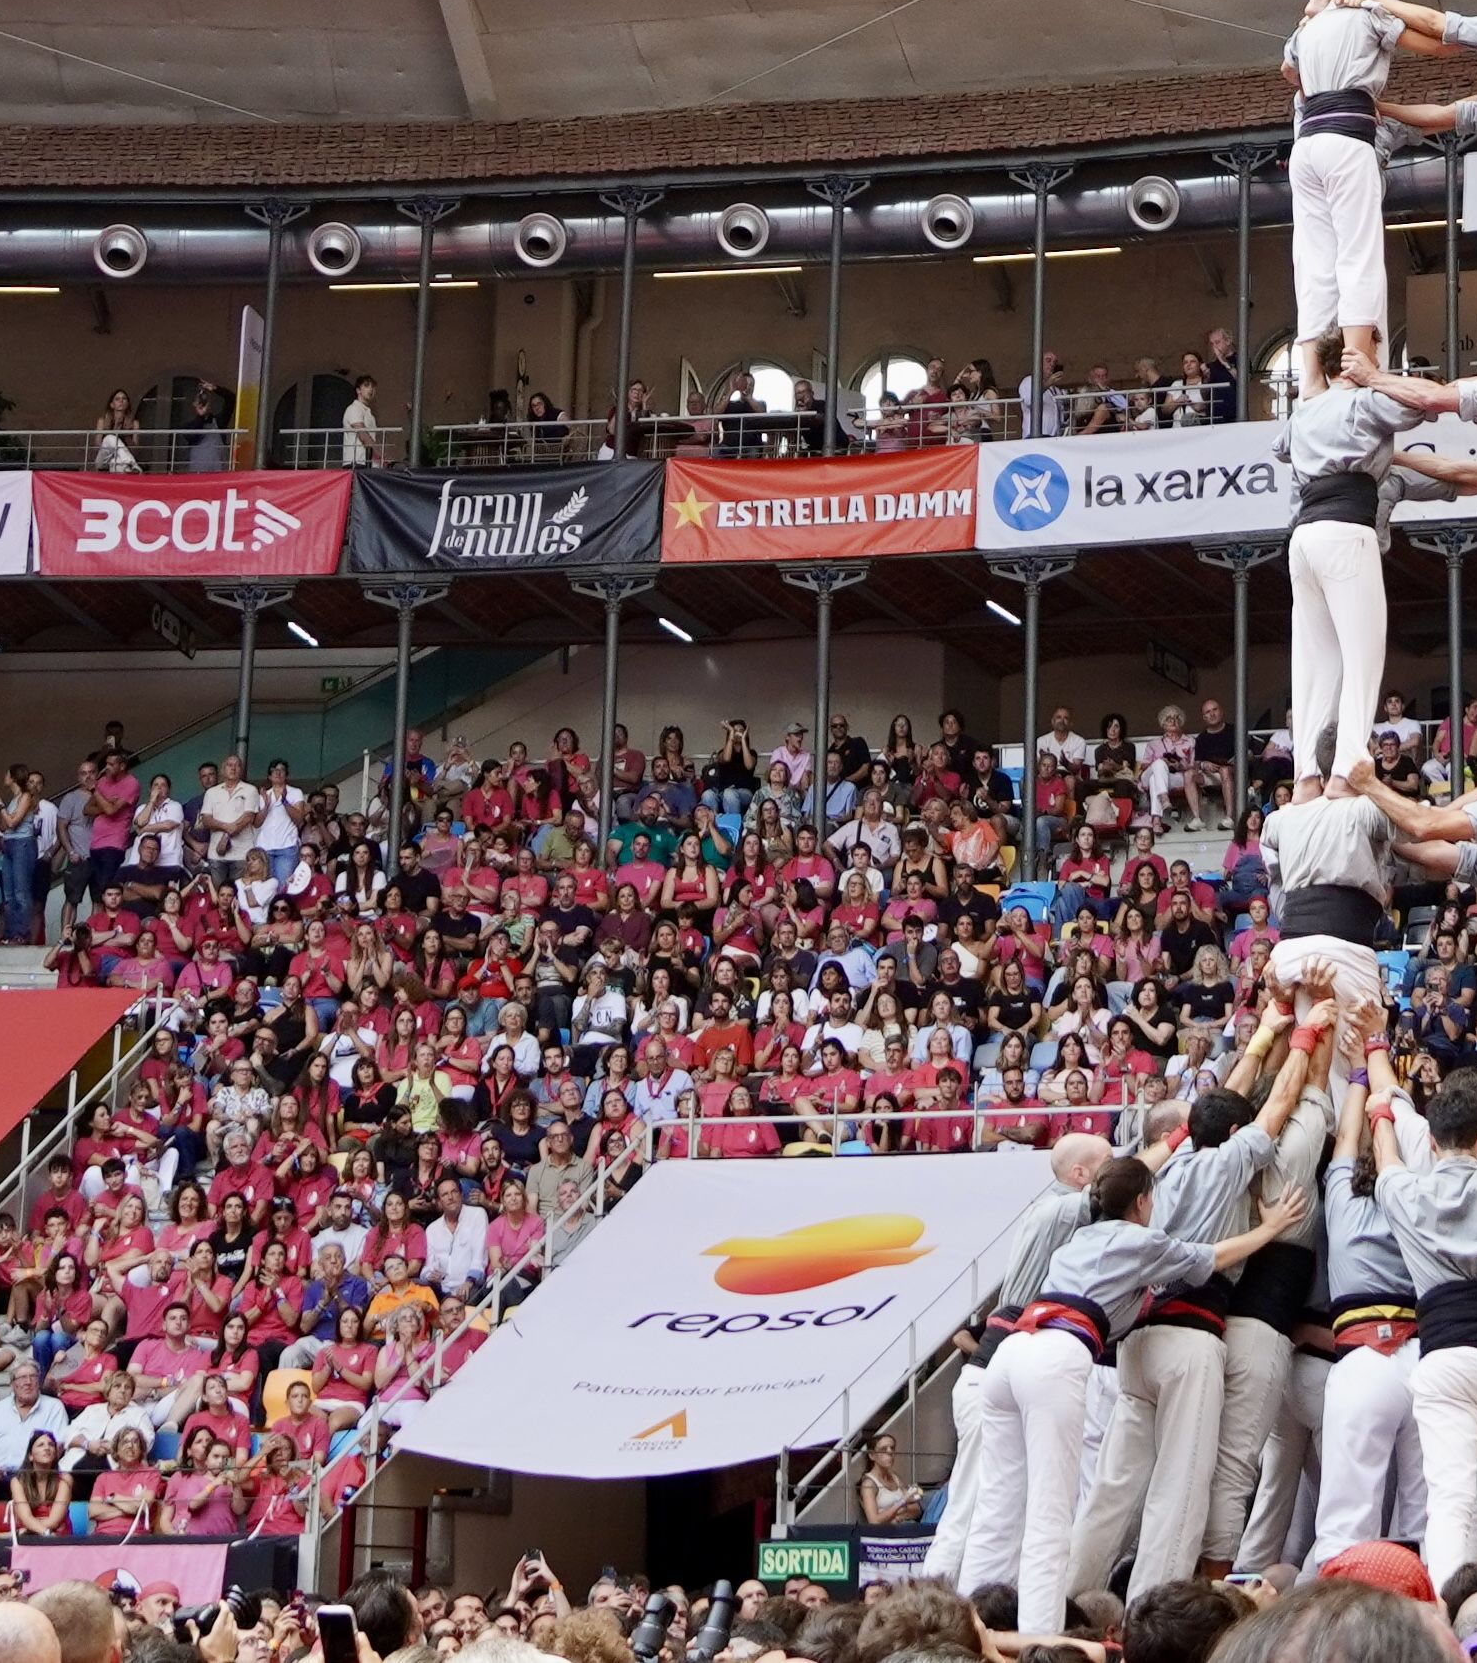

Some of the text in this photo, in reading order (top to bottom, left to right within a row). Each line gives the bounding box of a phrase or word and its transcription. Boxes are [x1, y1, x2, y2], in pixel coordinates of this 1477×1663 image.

[717, 488, 973, 528] ESTRELLA DAMM
[1084, 462, 1278, 509] la xarxa
[76, 488, 249, 553] 3cat
[426, 478, 517, 559] forn
[444, 493, 582, 557] de nulles
[627, 1295, 898, 1339] repsol
[572, 1374, 825, 1396] Patrocinador principal
[763, 1548, 844, 1574] SORTIDA
